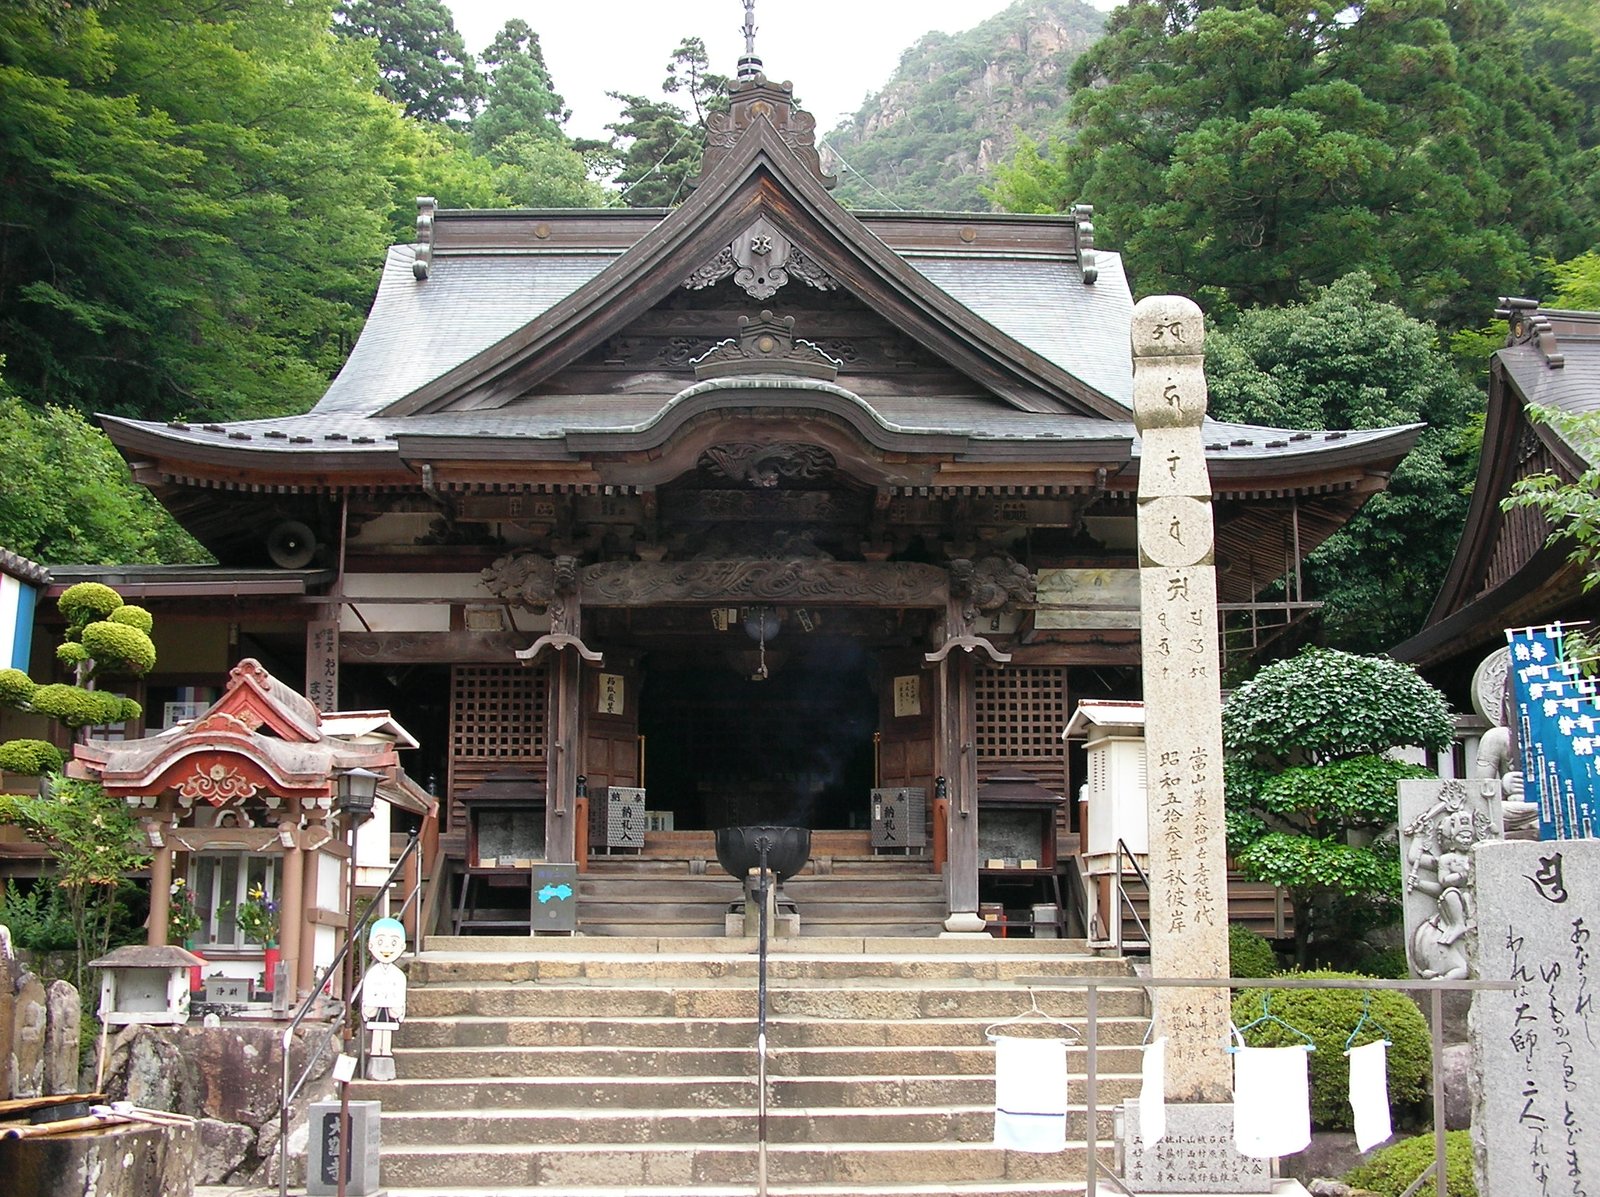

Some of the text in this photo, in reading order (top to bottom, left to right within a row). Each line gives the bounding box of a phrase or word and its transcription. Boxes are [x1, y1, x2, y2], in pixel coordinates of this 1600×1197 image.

[621, 806, 632, 841] 納札入
[884, 806, 896, 841] 納札入
